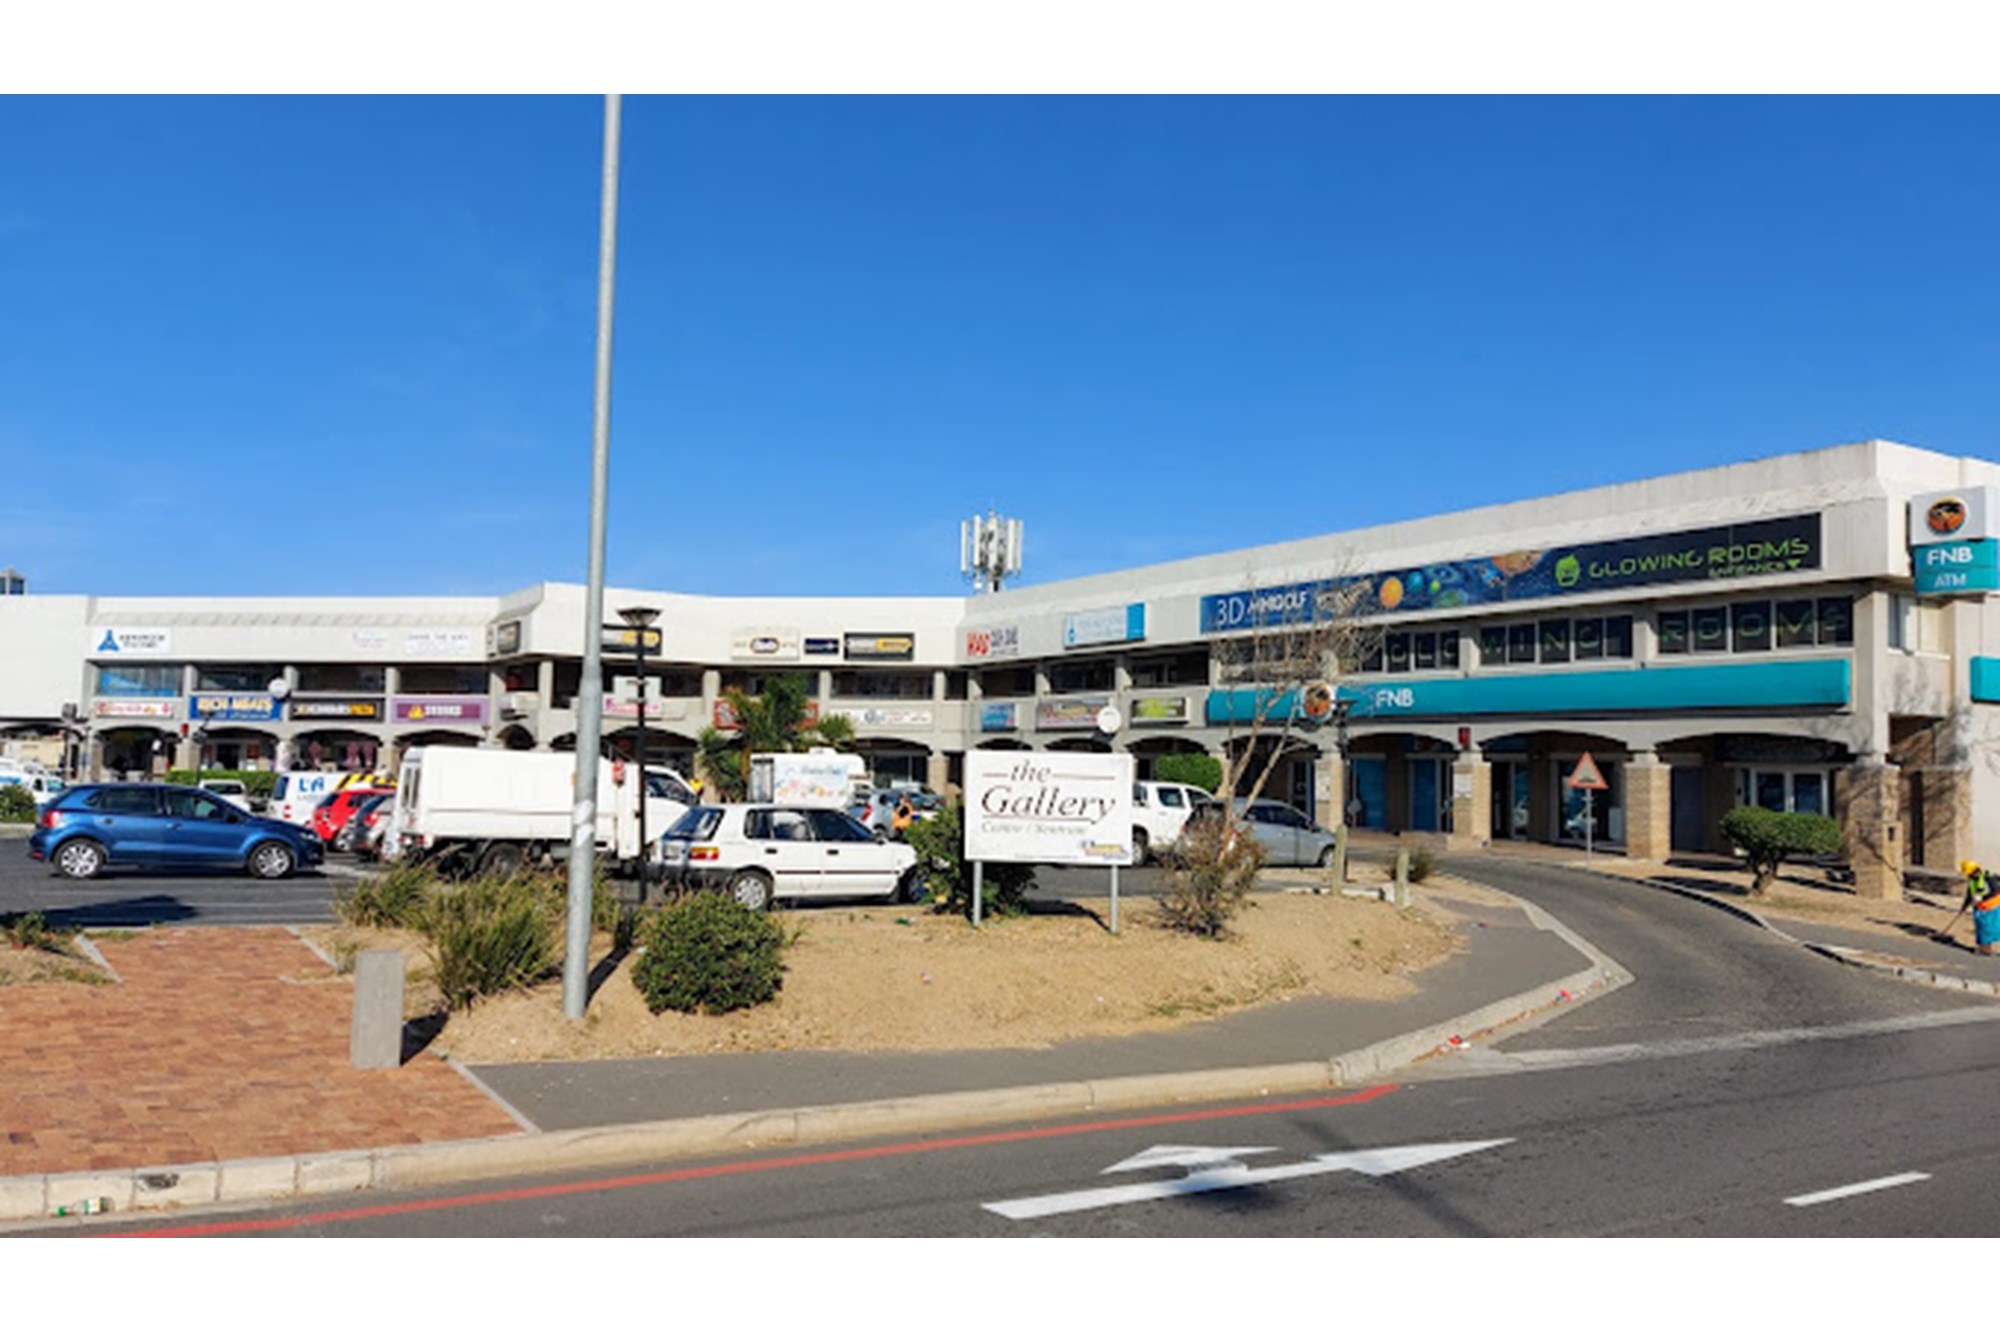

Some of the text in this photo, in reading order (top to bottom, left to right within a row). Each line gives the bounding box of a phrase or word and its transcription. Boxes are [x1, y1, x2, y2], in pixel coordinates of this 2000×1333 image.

[1588, 537, 1810, 578] GLOWING ROOMS
[1926, 546, 1974, 566] FNB
[1934, 573, 1967, 588] ATM
[1216, 597, 1244, 626] 3D
[1375, 688, 1415, 708] FNB
[1010, 760, 1051, 783] the
[981, 785, 1116, 825] Gallery
